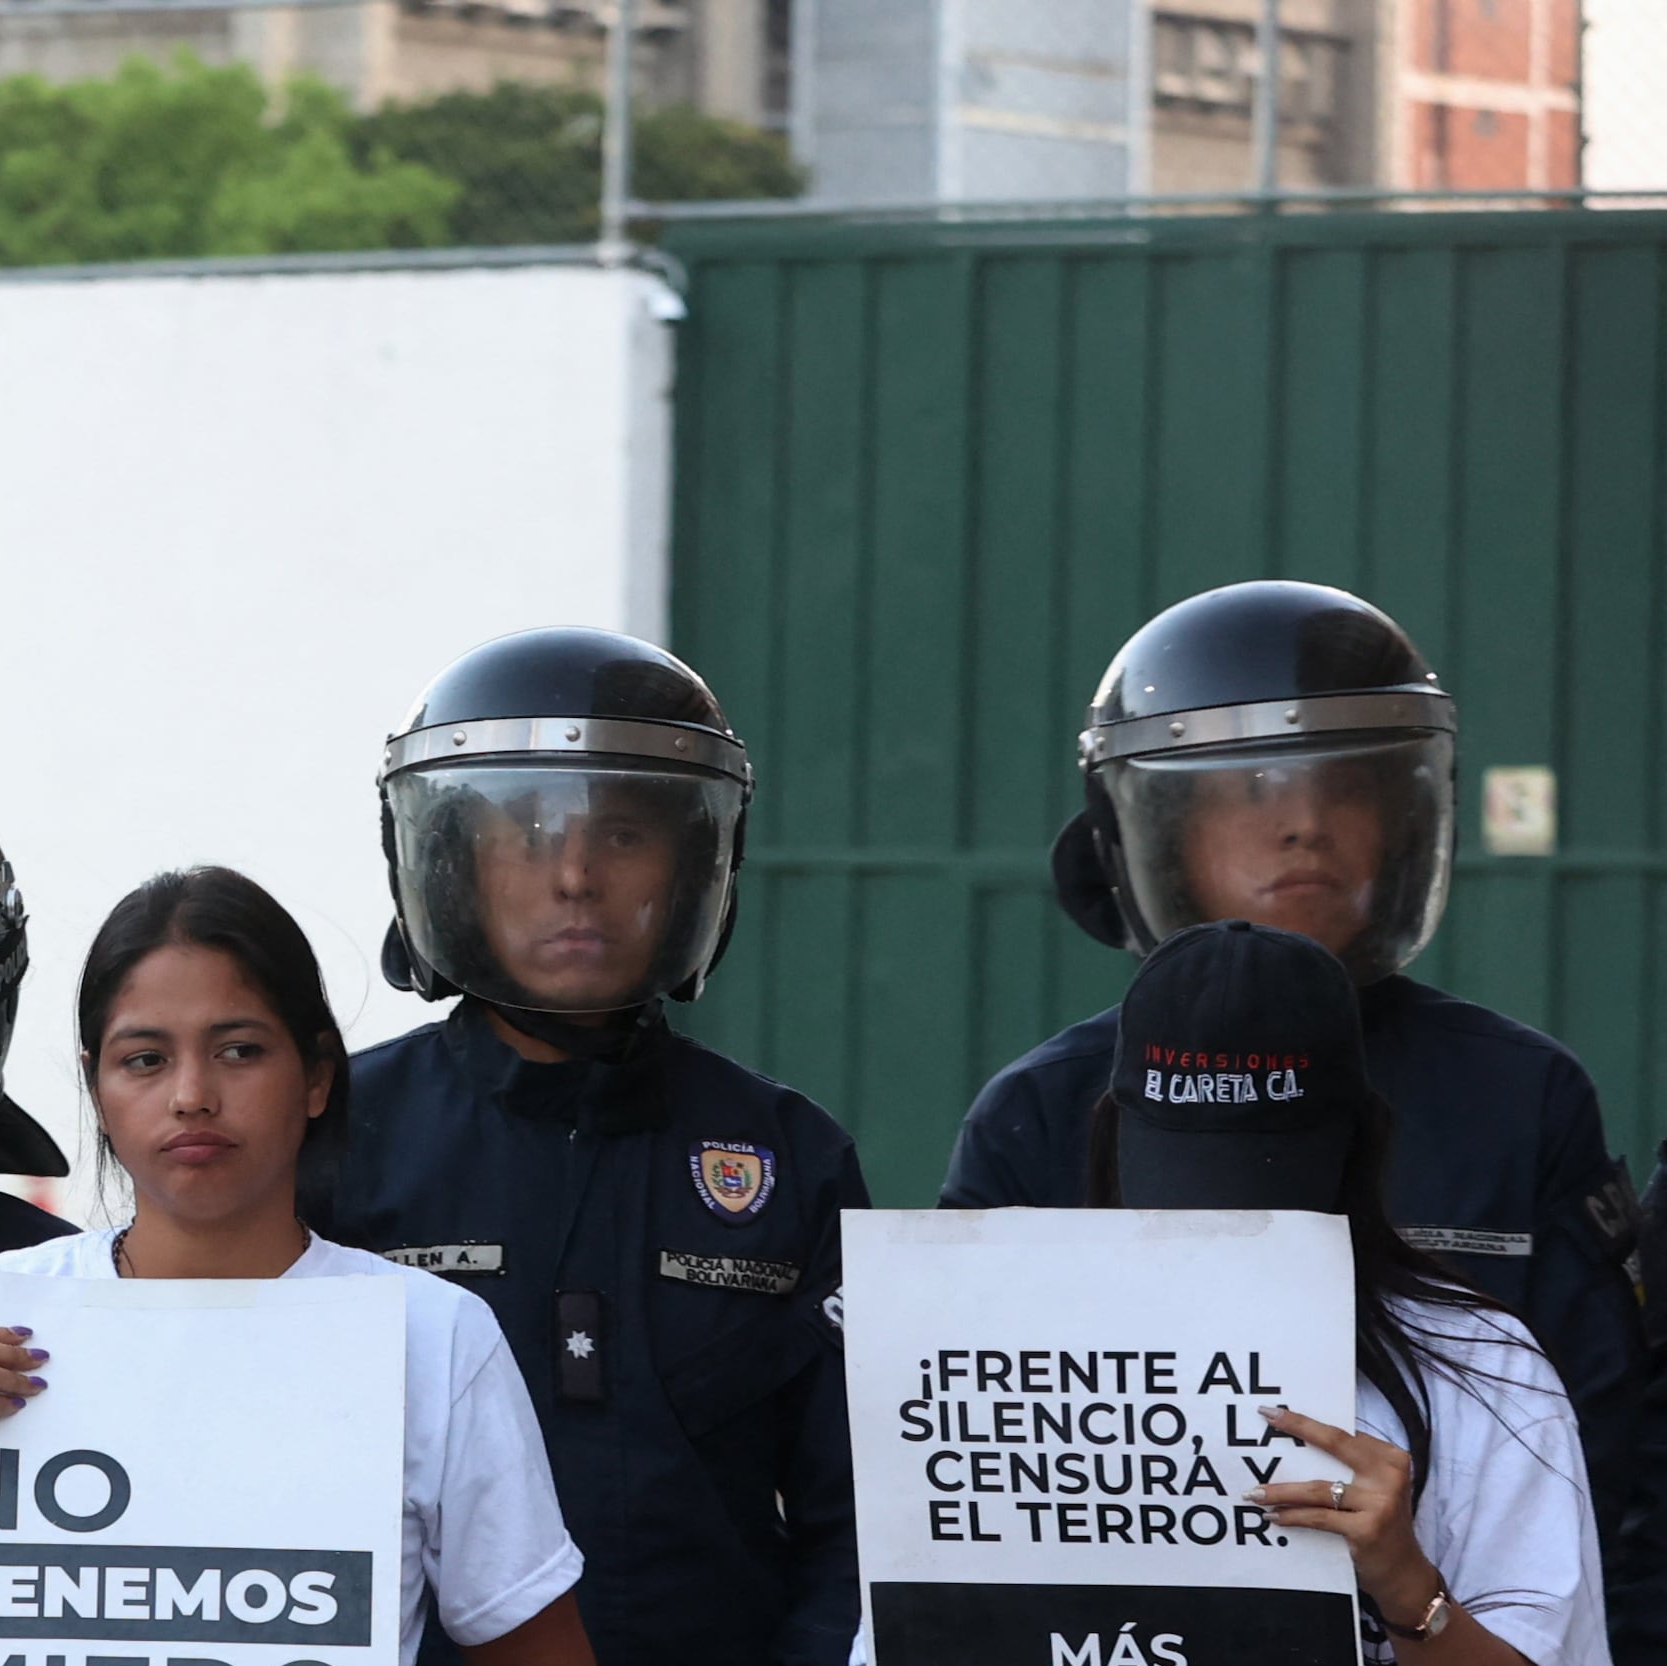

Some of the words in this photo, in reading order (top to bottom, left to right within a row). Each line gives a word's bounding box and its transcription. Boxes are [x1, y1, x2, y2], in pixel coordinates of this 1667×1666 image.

[1145, 1043, 1310, 1070] INVERSIONES
[1168, 1073, 1259, 1104] CARETA
[457, 1251, 478, 1264] A.
[920, 1349, 1178, 1401] ¡FRENTE
[1197, 1352, 1281, 1395] AL
[899, 1399, 1203, 1452] SILENCIO,
[926, 1450, 1228, 1496] CENSURA
[1241, 1456, 1283, 1485] Y
[930, 1500, 1001, 1542] EL
[1017, 1502, 1289, 1547] TERROR.
